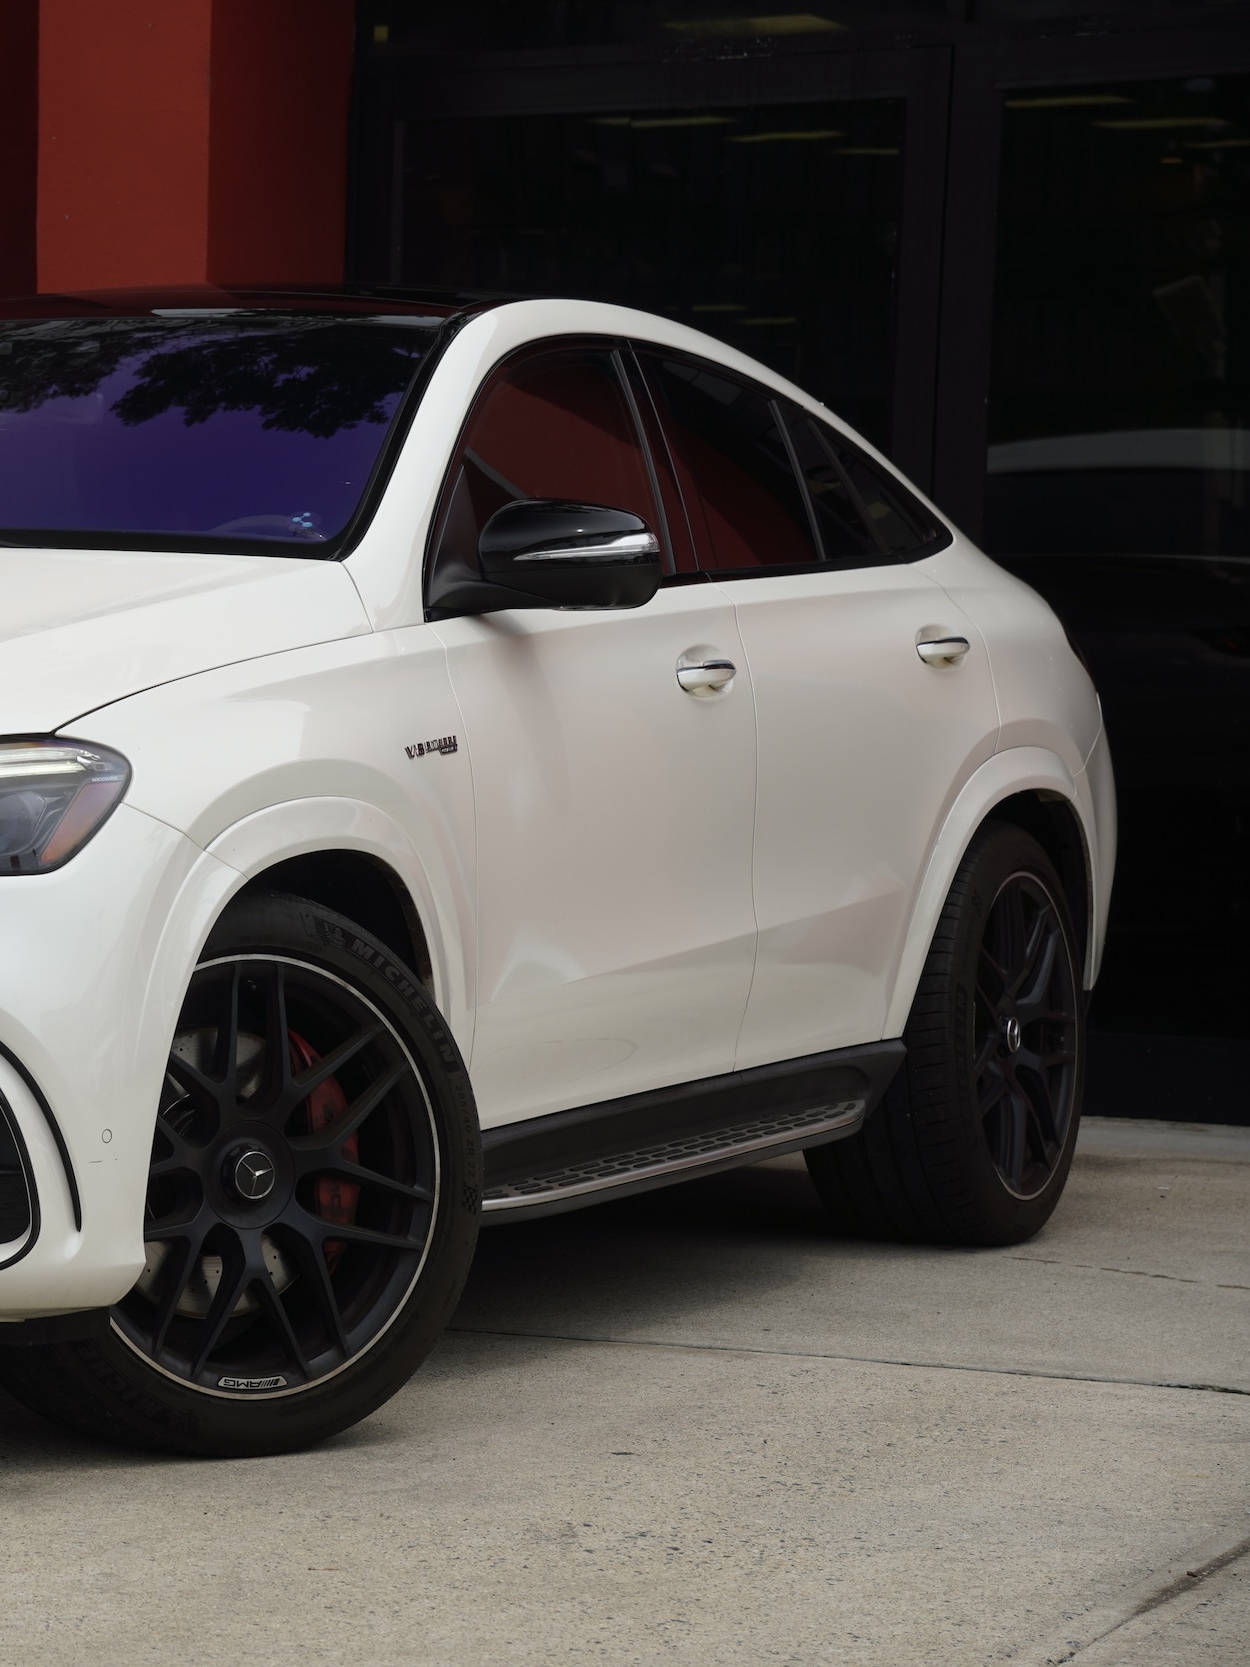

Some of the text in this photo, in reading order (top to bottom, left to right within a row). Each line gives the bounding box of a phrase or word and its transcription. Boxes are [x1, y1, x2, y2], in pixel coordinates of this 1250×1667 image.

[350, 938, 454, 1062] MICHELIN
[455, 1084, 476, 1178] 285/40 ZR 22
